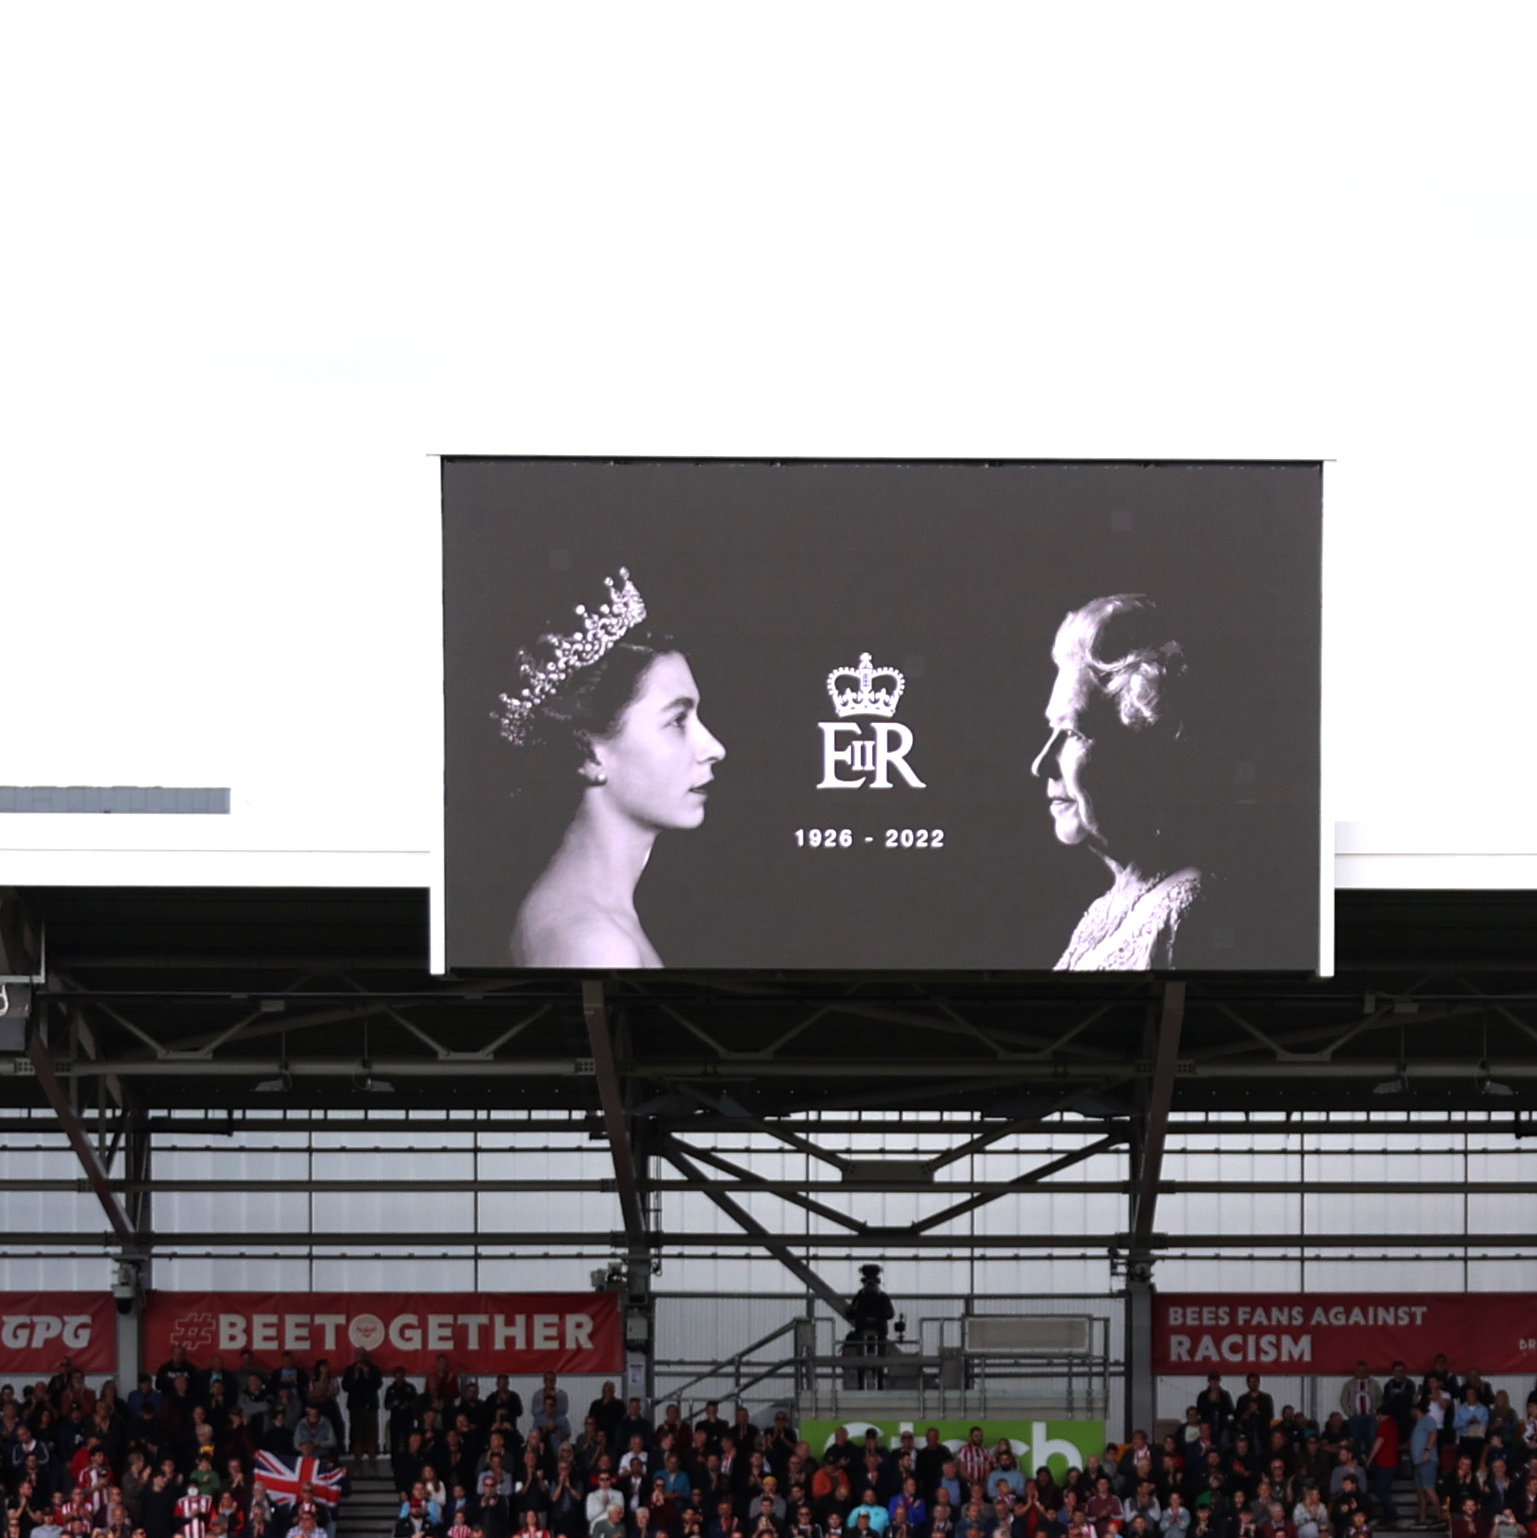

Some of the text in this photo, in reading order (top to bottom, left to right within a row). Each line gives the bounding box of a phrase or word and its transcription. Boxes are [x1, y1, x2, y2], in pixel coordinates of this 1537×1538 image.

[794, 828, 853, 848] 1926
[885, 828, 945, 848] 2022
[1168, 1307, 1428, 1326] BEES FANS AGAINST
[1169, 1334, 1312, 1362] RACISM
